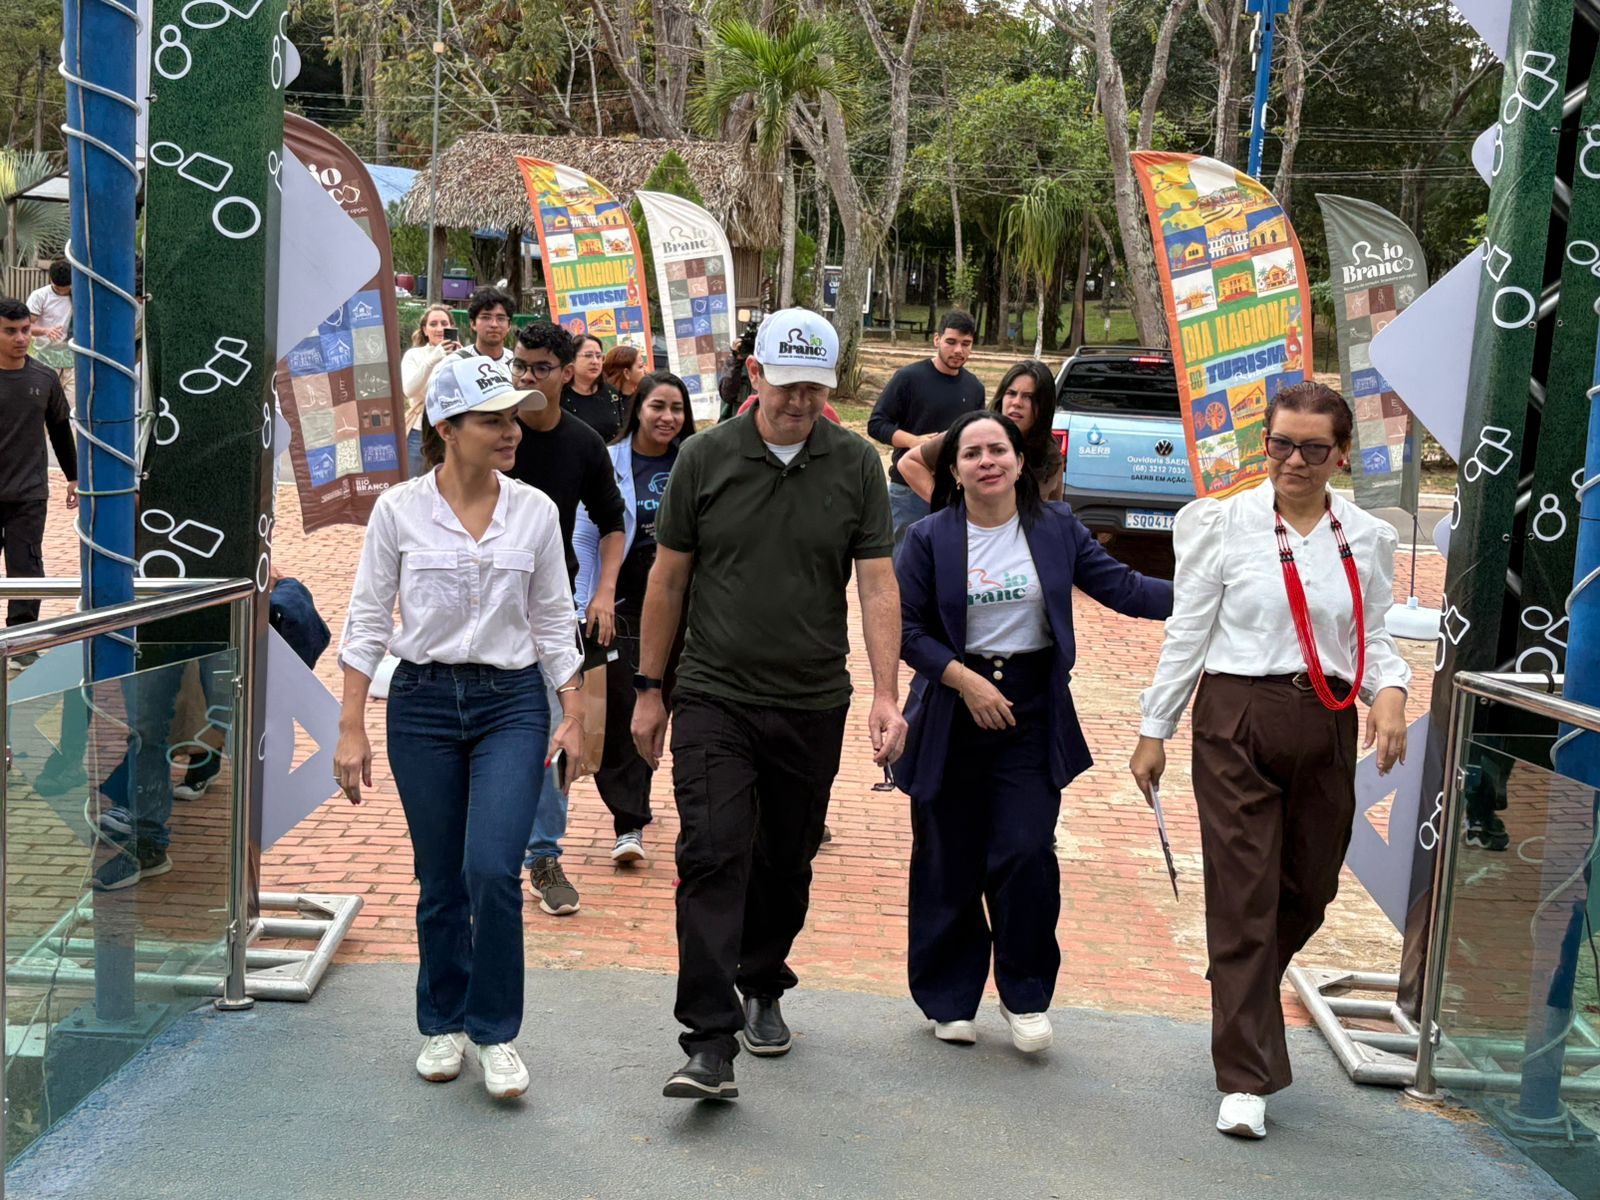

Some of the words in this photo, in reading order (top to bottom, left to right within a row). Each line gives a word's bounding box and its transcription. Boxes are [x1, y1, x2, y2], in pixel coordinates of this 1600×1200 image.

[1342, 256, 1414, 284] Branco
[552, 265, 576, 291] DIA
[569, 288, 629, 307] TURISM
[1181, 320, 1215, 364] DIA
[1206, 343, 1289, 384] TURISM
[1079, 446, 1111, 455] SAERB
[1127, 455, 1164, 464] Ouvidoria
[1149, 465, 1167, 474] 3212
[1169, 466, 1186, 475] 7035
[356, 482, 389, 491] BRANCO
[1166, 475, 1187, 485] AÇÃO
